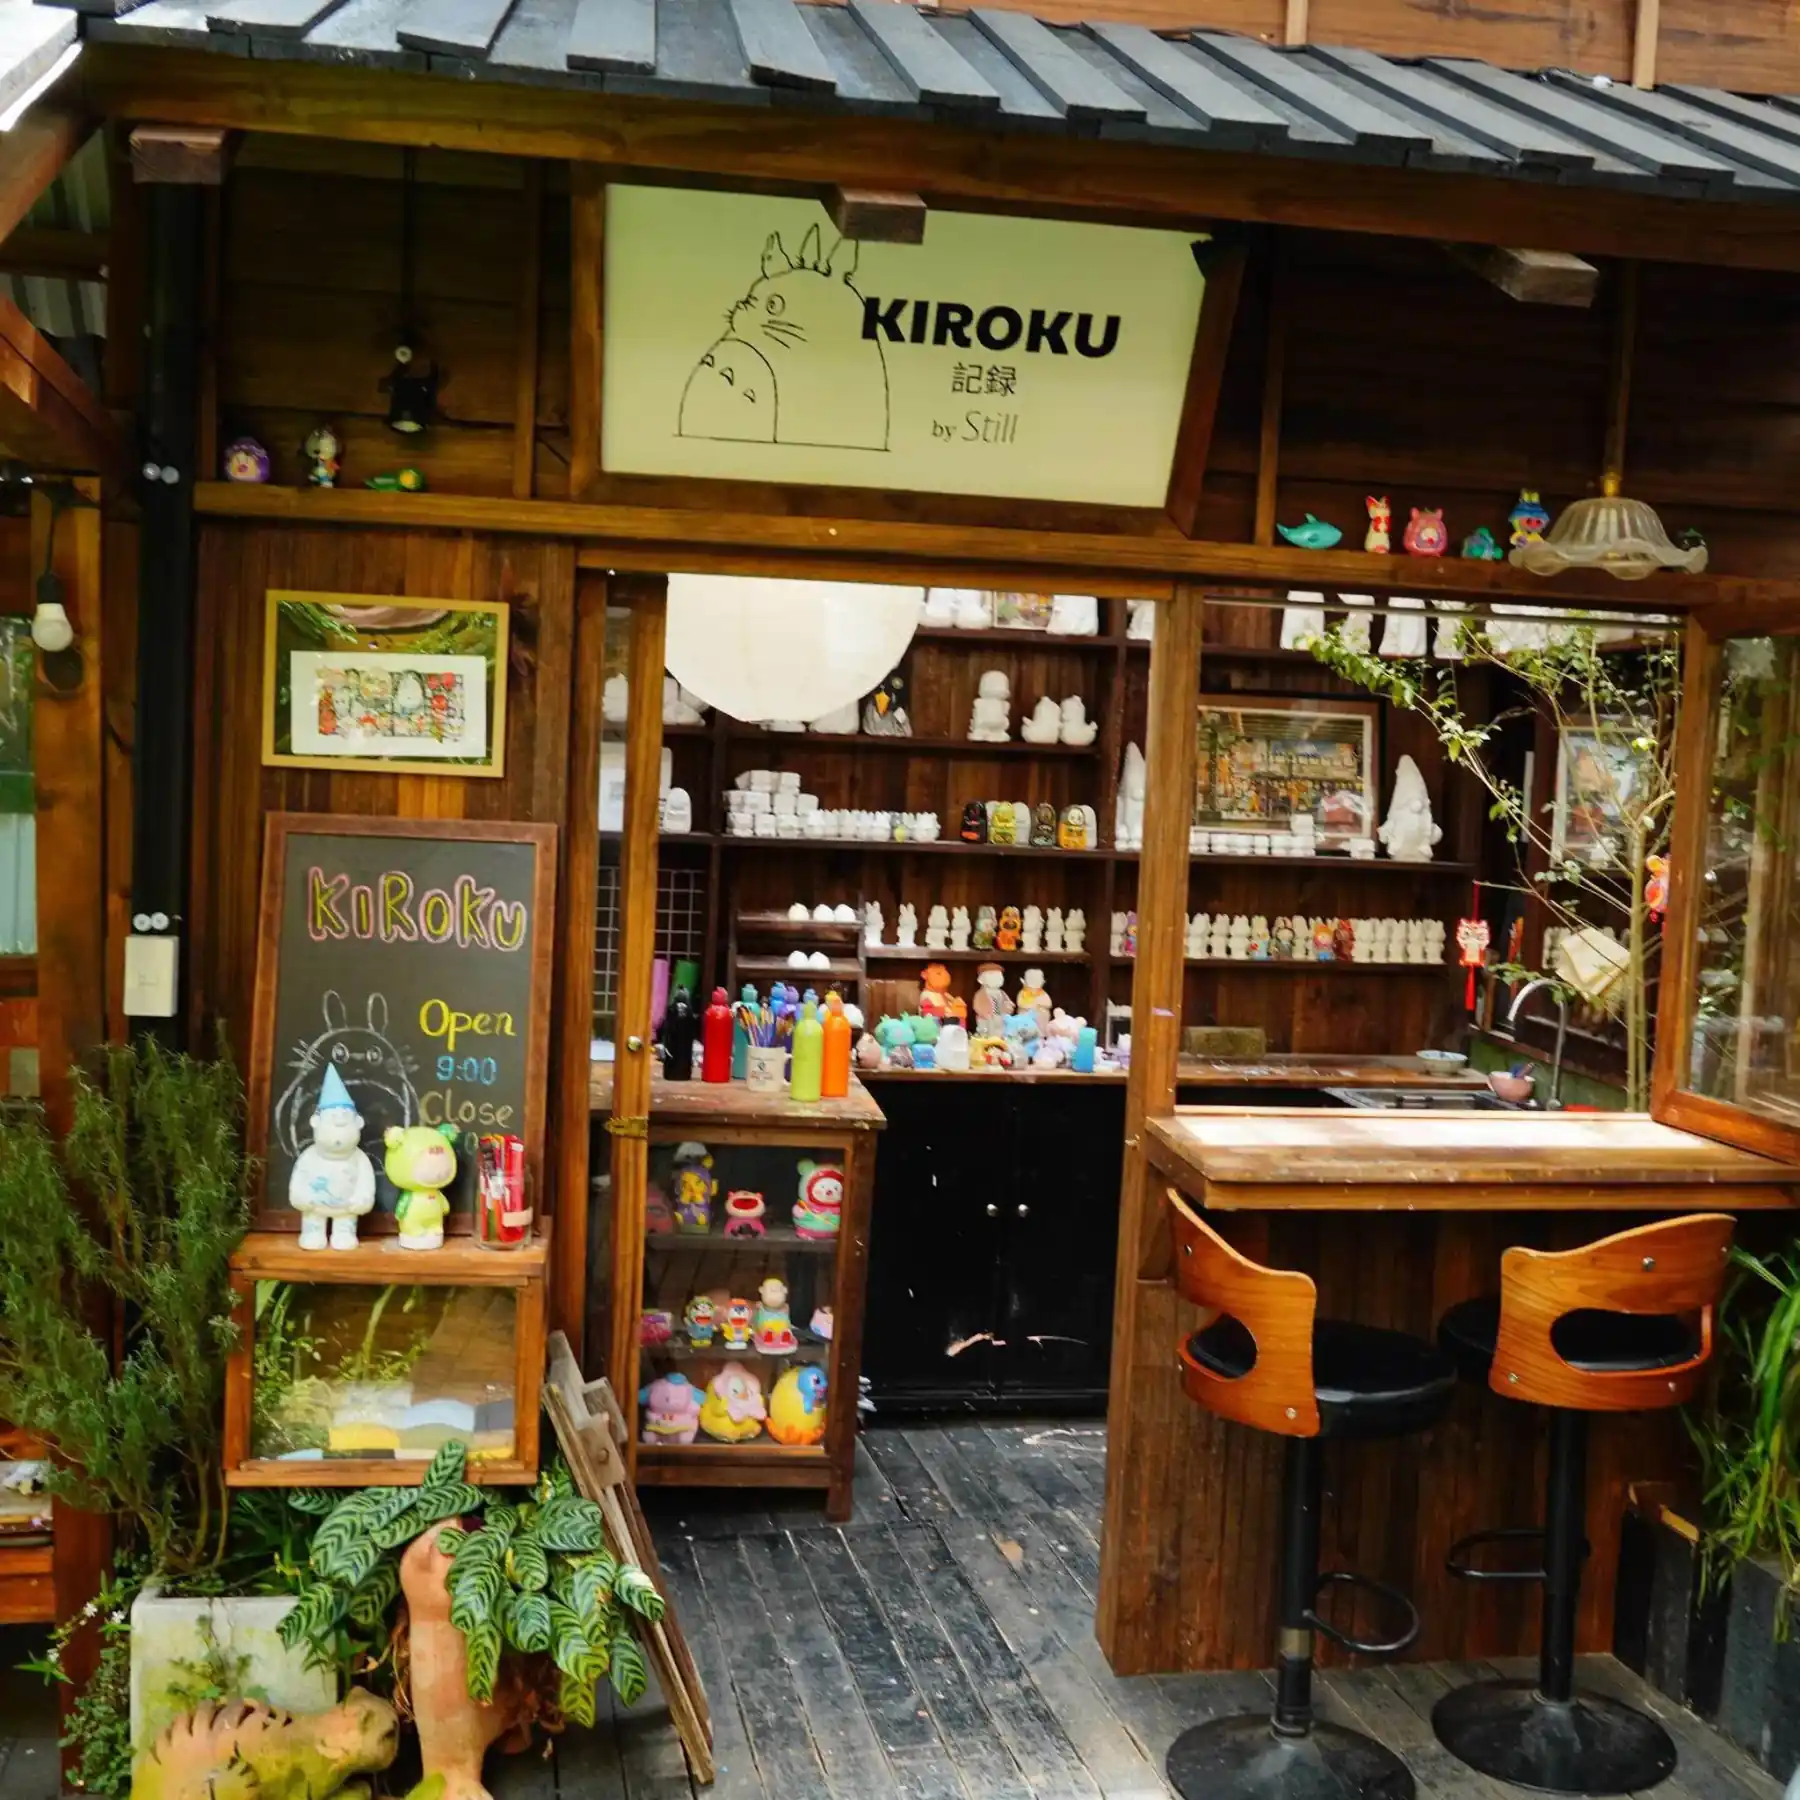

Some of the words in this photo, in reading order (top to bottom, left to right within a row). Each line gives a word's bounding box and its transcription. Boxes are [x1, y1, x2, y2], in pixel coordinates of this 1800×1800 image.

[861, 297, 1121, 359] KIROKU
[951, 361, 1017, 397] 記録
[931, 419, 957, 443] by
[961, 410, 1018, 444] Still
[419, 999, 517, 1051] Open
[436, 1055, 497, 1085] 9:00
[420, 1089, 514, 1129] Close
